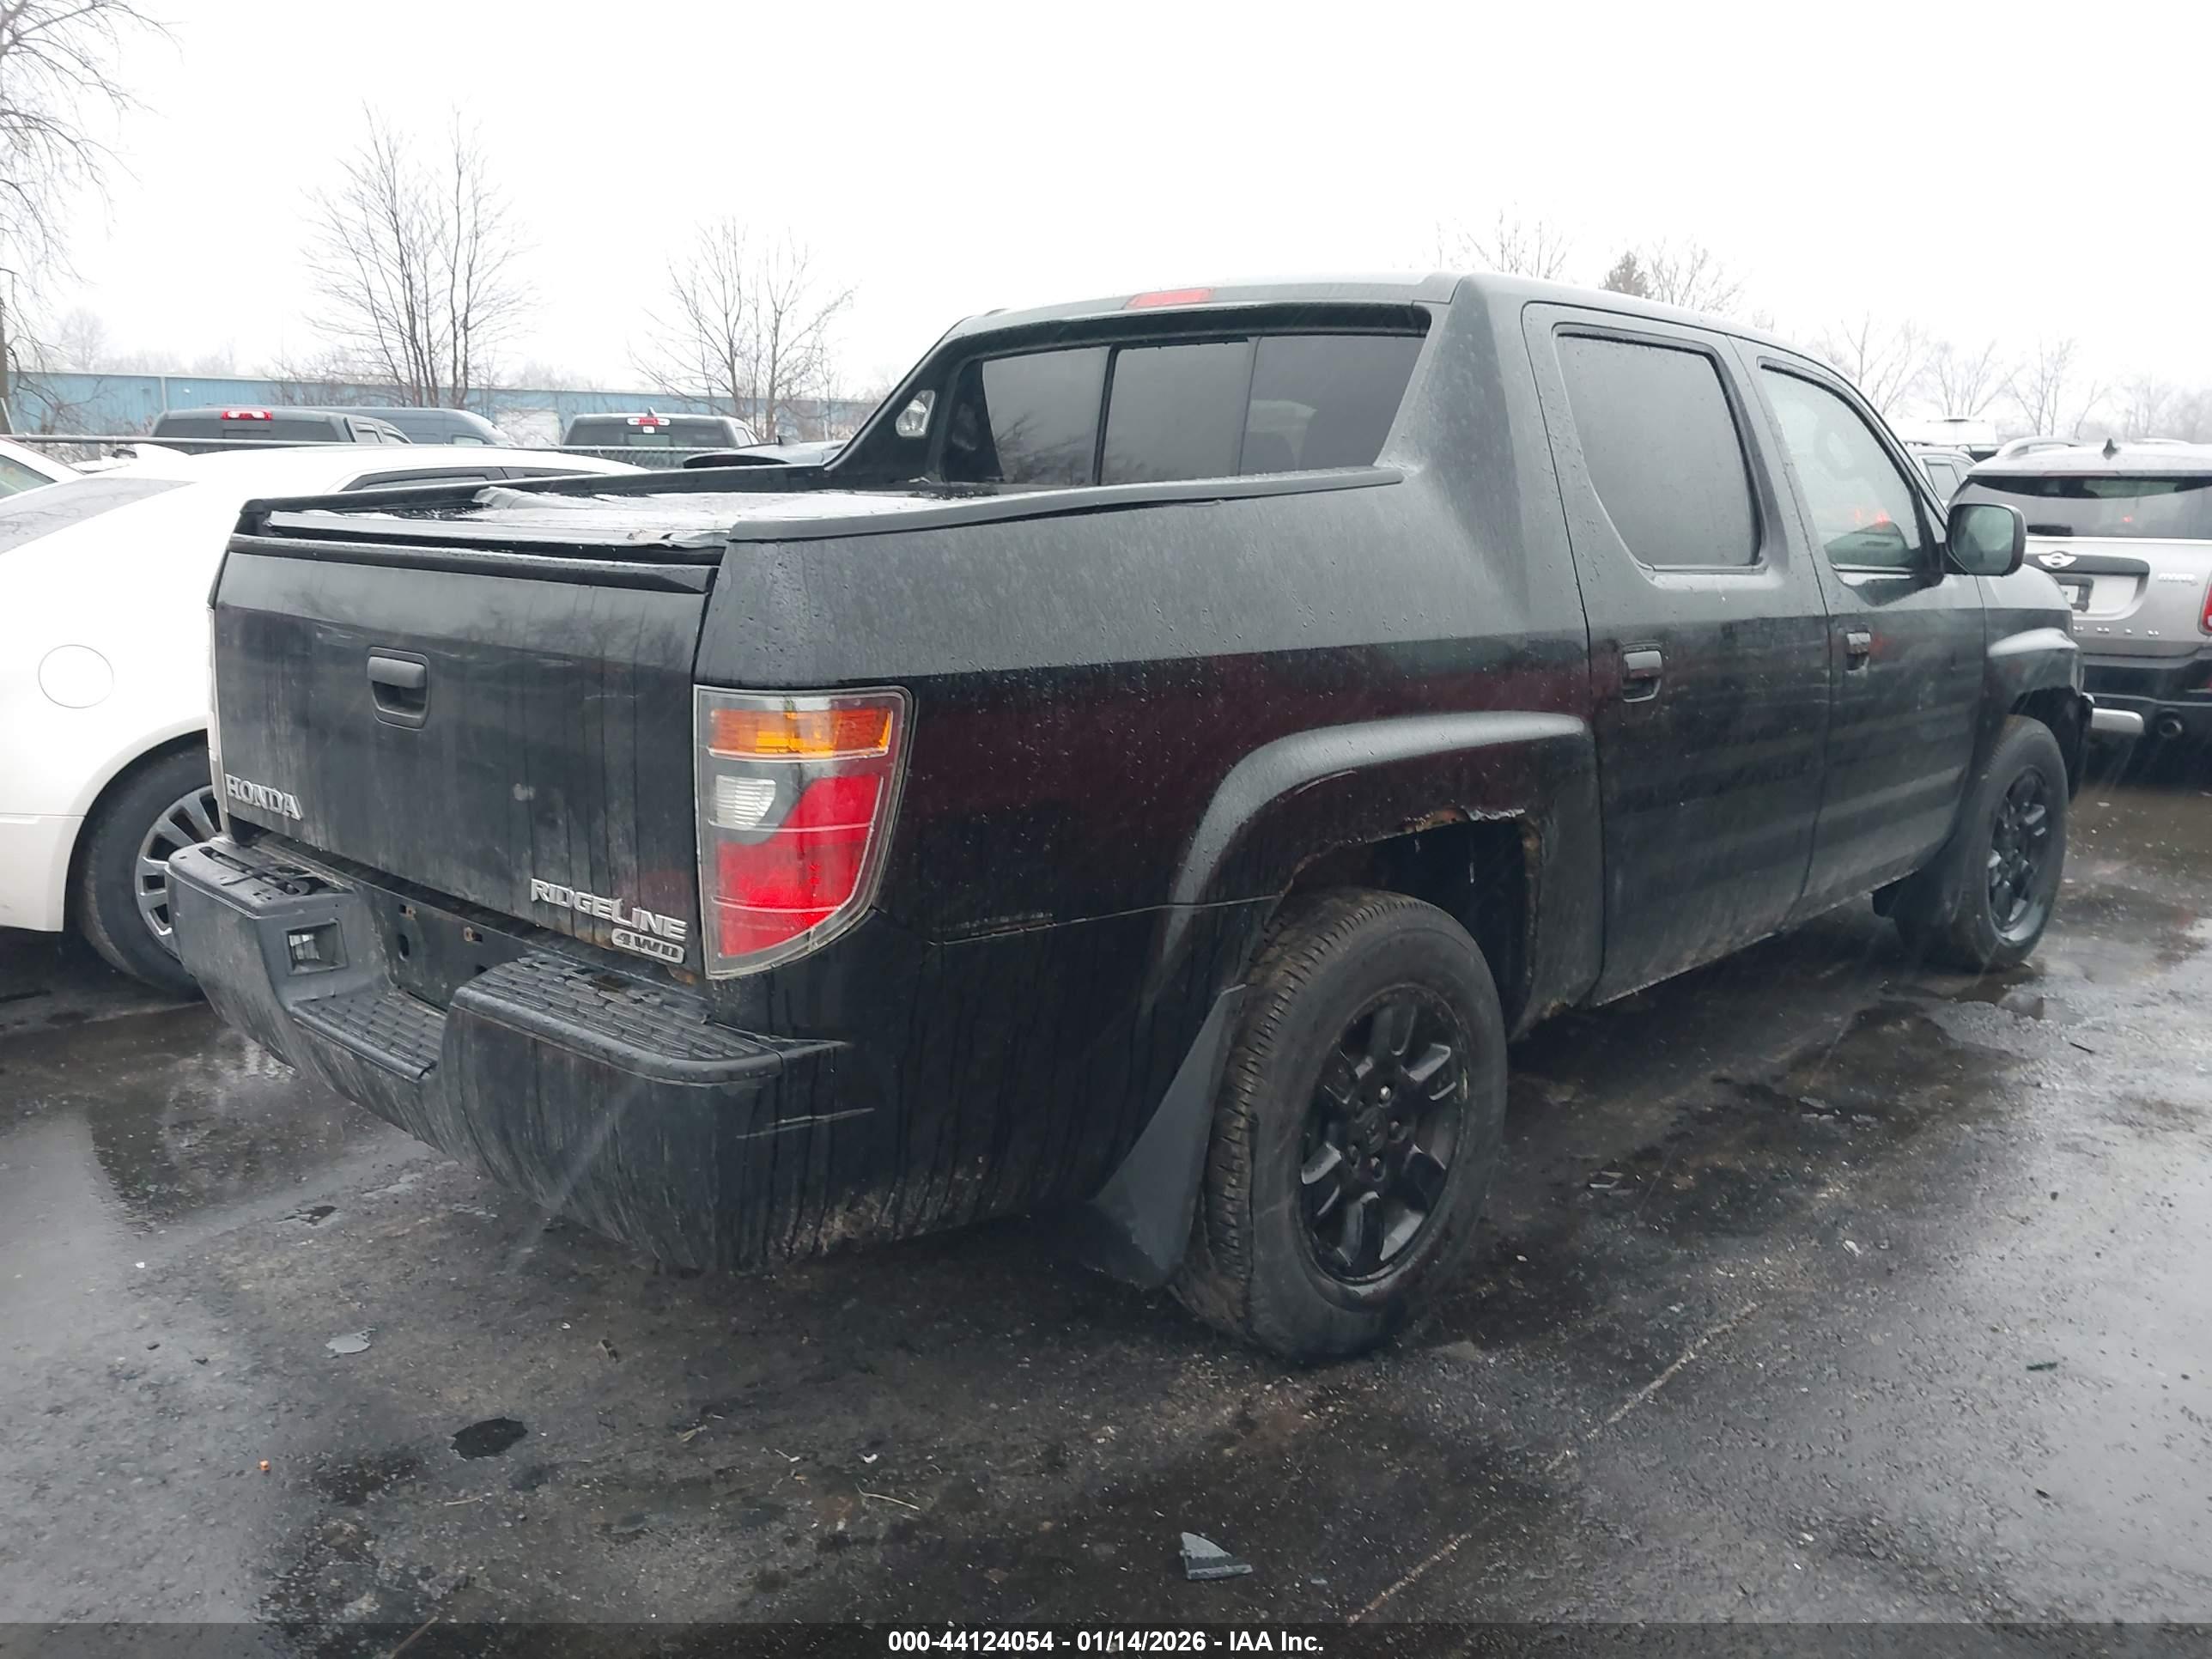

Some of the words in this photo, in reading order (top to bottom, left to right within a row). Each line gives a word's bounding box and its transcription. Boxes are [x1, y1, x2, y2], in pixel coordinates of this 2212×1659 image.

[224, 773, 303, 821] HONDA
[531, 878, 688, 941] RIDGELINE
[613, 930, 682, 961] 4WD
